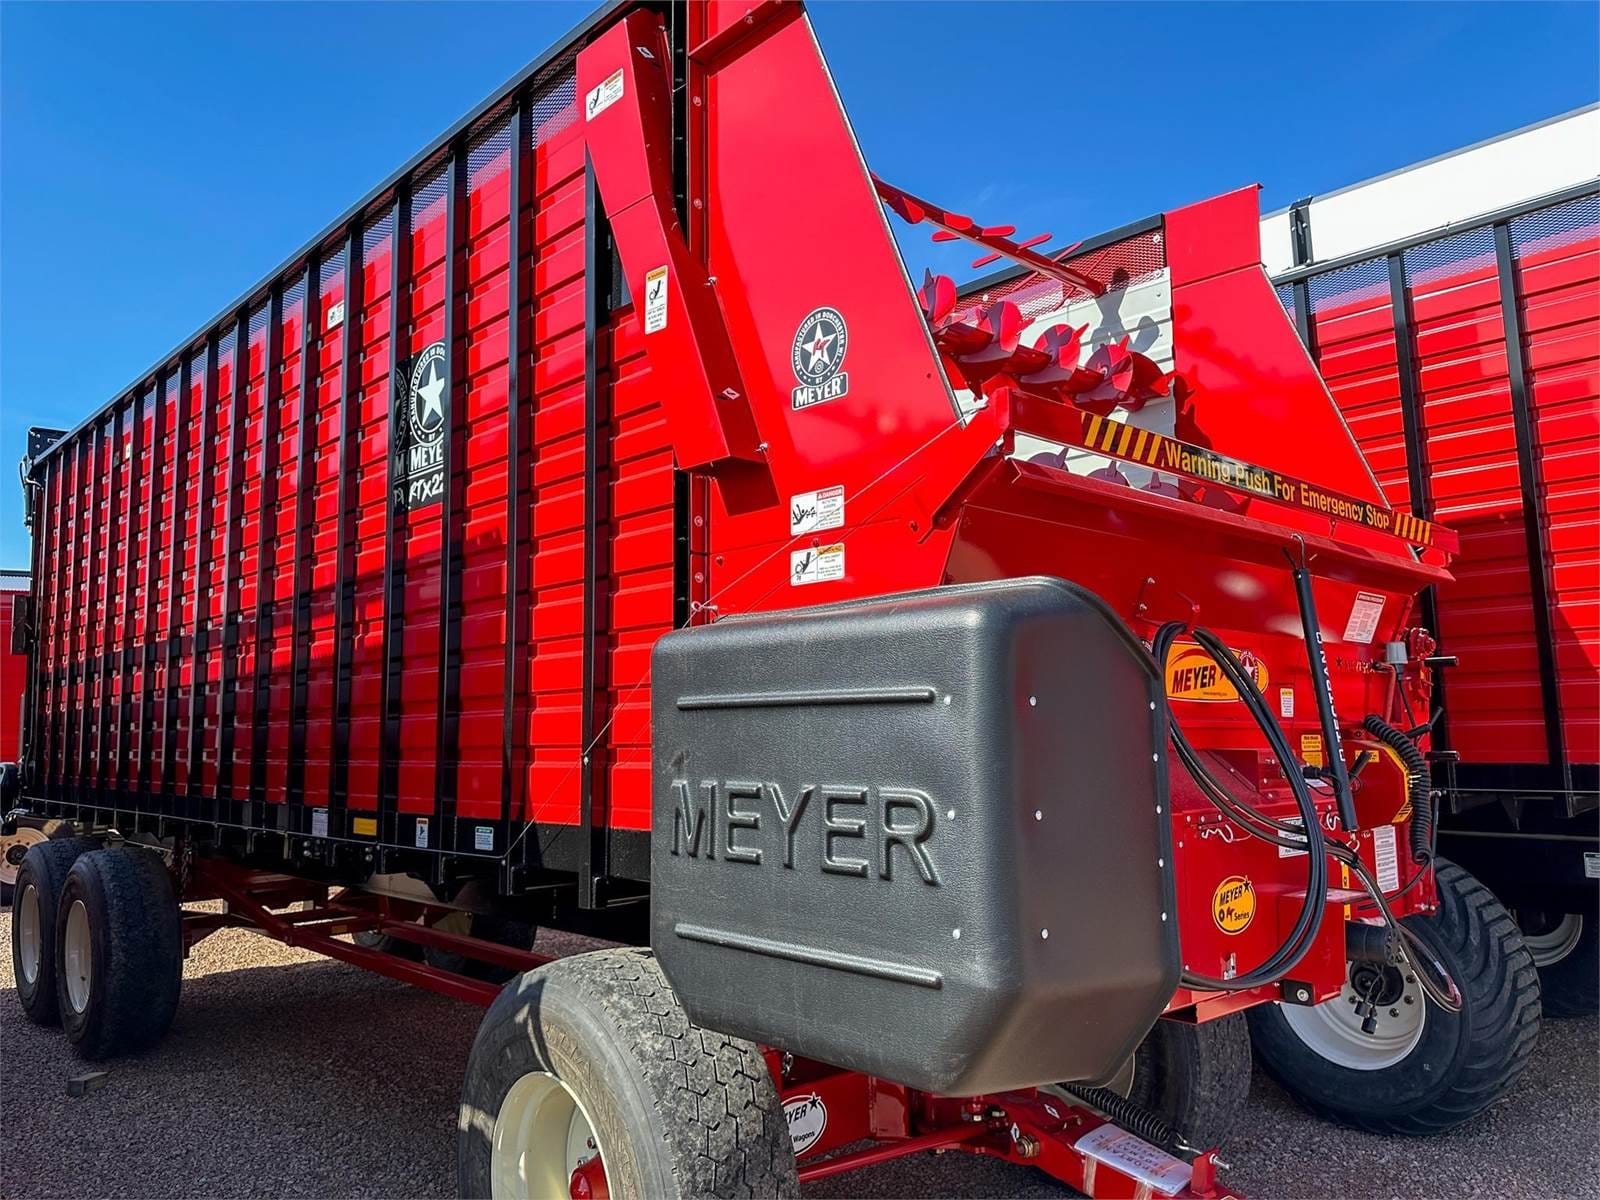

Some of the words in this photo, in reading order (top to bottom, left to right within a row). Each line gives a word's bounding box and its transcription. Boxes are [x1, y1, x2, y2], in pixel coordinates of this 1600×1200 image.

[795, 377, 841, 407] MEYER
[410, 439, 444, 472] MEYE
[1164, 440, 1230, 481] Warning
[1235, 462, 1271, 495] Push
[1274, 474, 1296, 502] For
[1300, 483, 1364, 522] Emergency
[1366, 504, 1390, 530] Stop
[1172, 664, 1217, 694] MEYER
[674, 779, 943, 888] MEYER
[1219, 884, 1243, 907] MEYER
[1234, 911, 1250, 921] Series
[785, 1103, 808, 1124] YER
[793, 1130, 815, 1143] Wagons
